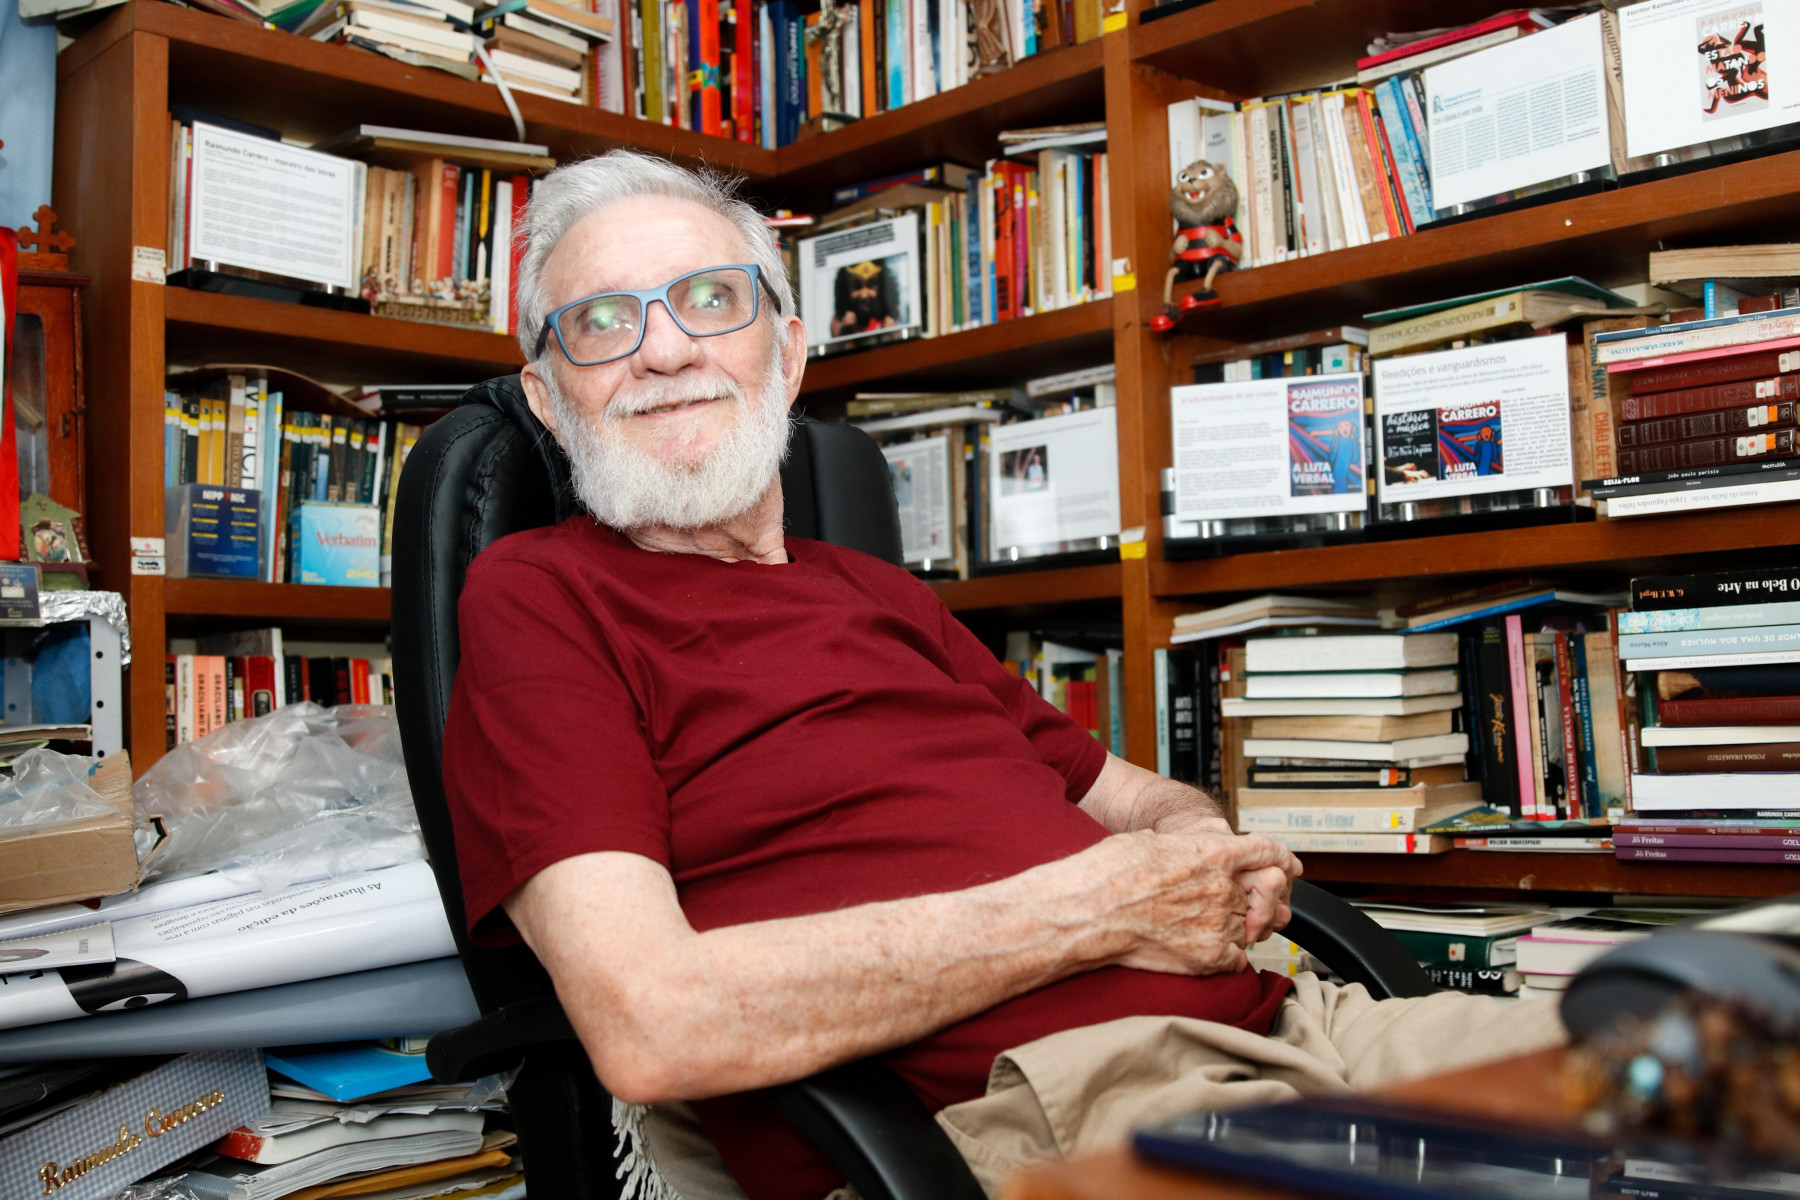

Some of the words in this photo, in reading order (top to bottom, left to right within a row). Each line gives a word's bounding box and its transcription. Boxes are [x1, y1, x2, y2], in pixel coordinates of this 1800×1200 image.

[1707, 79, 1766, 101] MENINOS
[1645, 327, 1660, 336] García
[1660, 324, 1681, 334] Márquez
[1737, 315, 1754, 323] Vargas
[1754, 313, 1768, 321] Llosa
[1636, 343, 1660, 351] VARGAS
[1659, 340, 1685, 348] MARIO
[1382, 366, 1427, 380] Reedições
[1437, 354, 1507, 373] vanguardismos
[1592, 370, 1608, 400] NAVA
[1291, 385, 1359, 400] RAIMUNDO
[1291, 396, 1359, 413] CARRERO
[1441, 405, 1498, 422] CARRERO
[1596, 444, 1610, 460] DE
[1292, 463, 1302, 473] A
[1304, 461, 1332, 472] LUTA
[1445, 464, 1452, 473] A
[1453, 461, 1477, 473] LUTA
[1292, 472, 1335, 484] VERBAL
[1667, 472, 1680, 480] joão
[1681, 470, 1696, 478] paulo
[1603, 476, 1640, 486] BEIJA-FLOR
[1691, 494, 1710, 503] Verde
[1710, 492, 1728, 501] Baile
[1728, 491, 1739, 499] do
[1739, 489, 1760, 498] Antes
[1618, 501, 1637, 509] Telles
[1637, 497, 1669, 507] Fagundes
[1669, 496, 1687, 505] Lygia
[316, 531, 377, 548] Verbatim
[1717, 582, 1742, 594] Arte
[1745, 580, 1759, 589] na
[1762, 578, 1789, 592] Belo
[1790, 577, 1800, 590] O
[1639, 589, 1659, 600] Hegel
[1677, 589, 1684, 597] G.
[1666, 614, 1695, 624] JORGE
[1681, 638, 1717, 647] MULHER
[1720, 636, 1738, 644] BOA
[1740, 635, 1760, 643] UMA
[1763, 634, 1775, 642] DE
[1778, 633, 1800, 642] AMOR
[1629, 641, 1651, 649] Munro
[1652, 640, 1669, 648] Alice
[197, 673, 207, 726] GRACILIANO
[213, 673, 223, 726] GRACILIANO
[1566, 752, 1575, 764] DE
[1707, 753, 1743, 761] DRAMÁTICO
[1567, 765, 1578, 801] RELATO
[1642, 836, 1665, 845] Freitas
[1645, 850, 1667, 859] Freitas
[366, 882, 382, 891] As
[262, 888, 316, 908] reproduzidas
[299, 886, 367, 909] ilustrações
[245, 903, 262, 914] nas
[281, 907, 298, 917] da
[153, 914, 189, 930] designer
[210, 909, 245, 927] páginas
[237, 914, 280, 932] edição
[157, 914, 209, 937] reproduções
[190, 922, 210, 933] com
